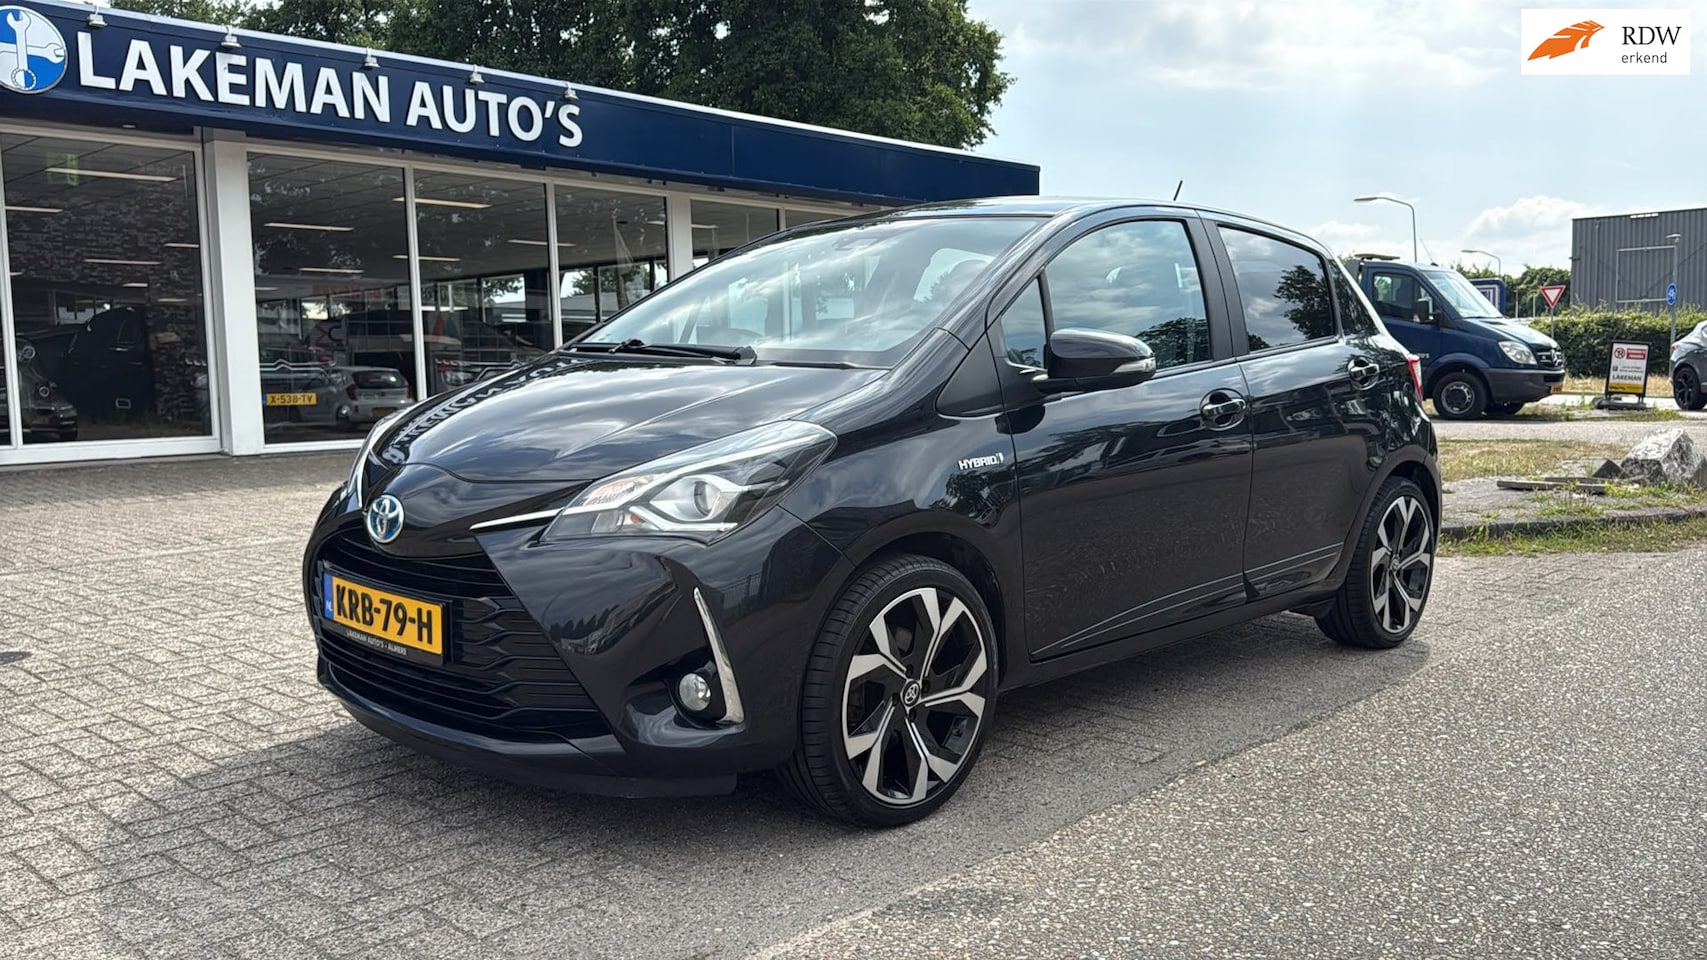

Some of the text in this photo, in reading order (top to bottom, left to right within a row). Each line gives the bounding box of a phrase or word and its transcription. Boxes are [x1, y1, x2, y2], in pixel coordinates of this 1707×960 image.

[77, 31, 583, 148] LAKEMAN AUTO'S
[1612, 374, 1642, 382] LAKEMAN
[336, 584, 433, 645] KRB-79-H
